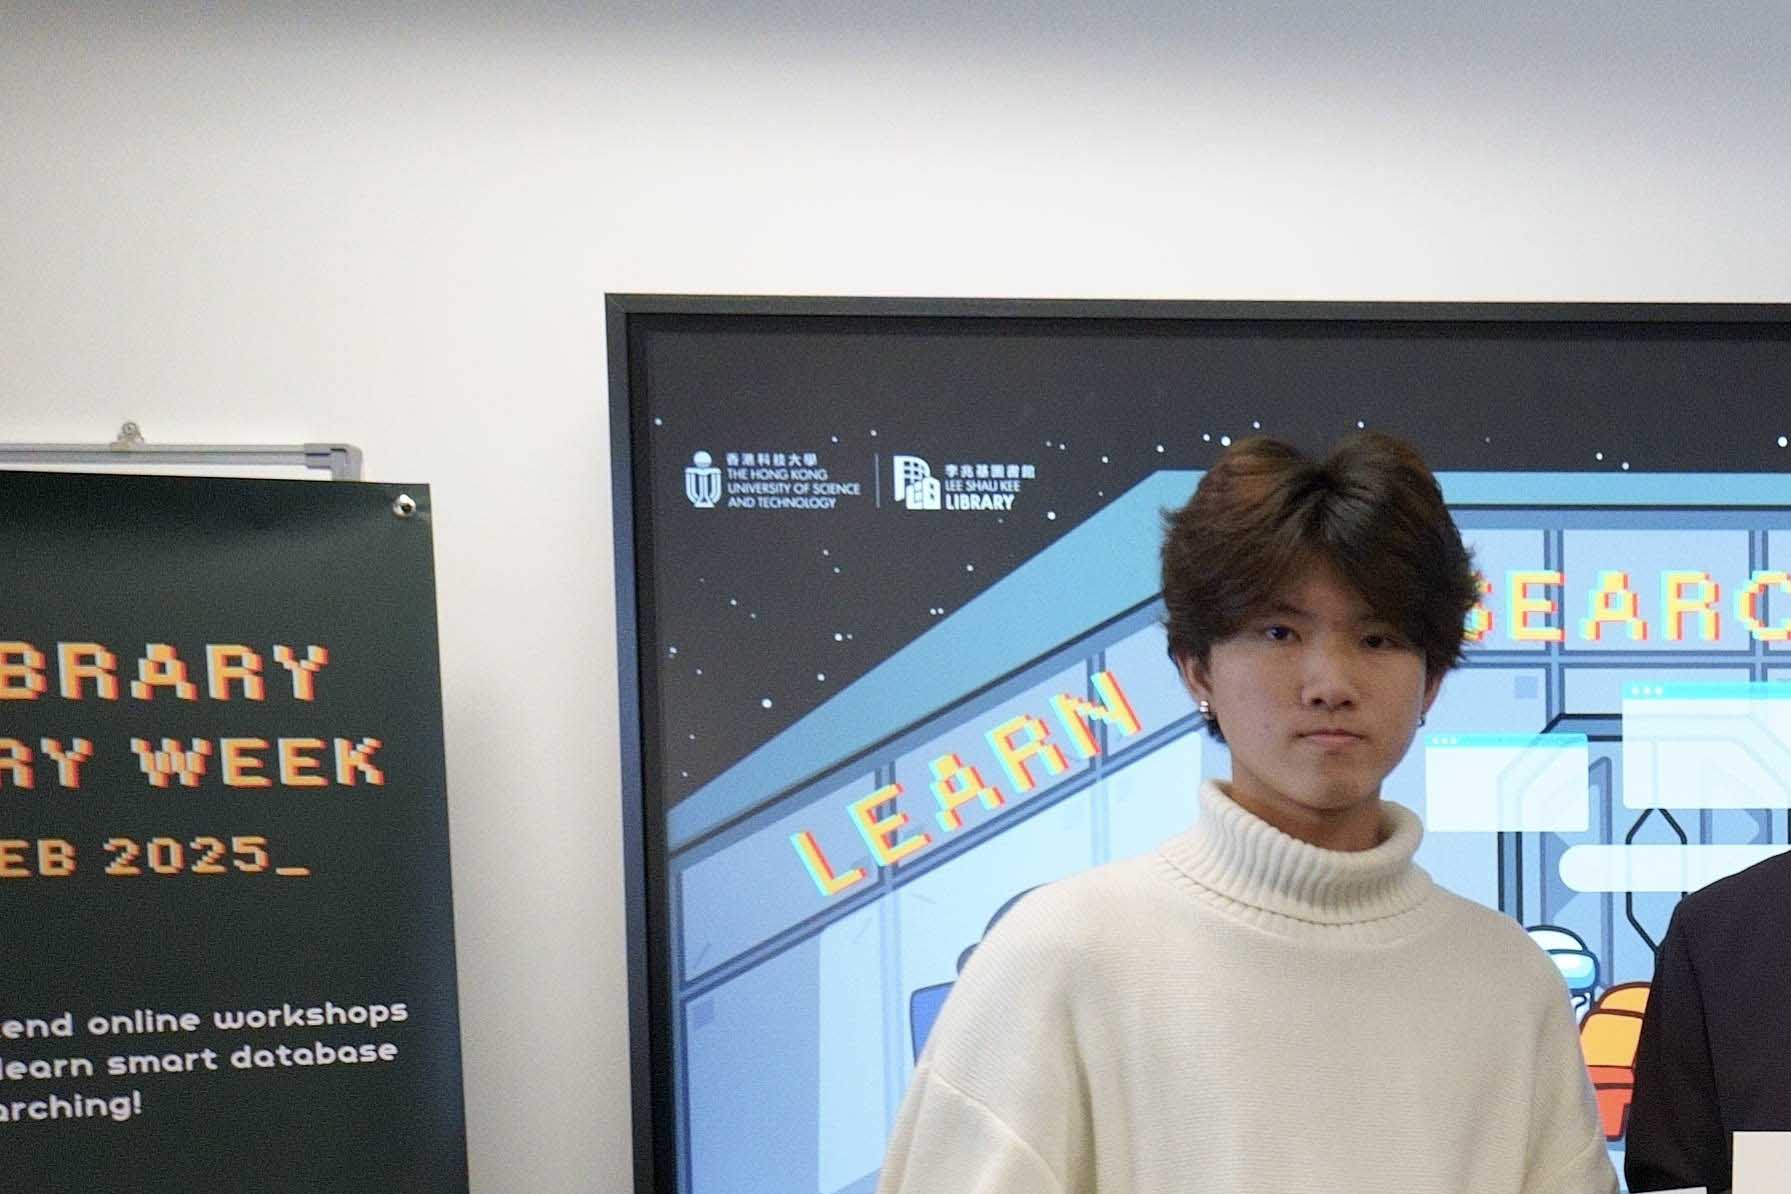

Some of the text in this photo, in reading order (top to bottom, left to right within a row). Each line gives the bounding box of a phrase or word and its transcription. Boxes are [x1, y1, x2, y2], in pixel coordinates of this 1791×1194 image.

[727, 468, 828, 480] THE HONG KONG
[728, 483, 861, 495] UNIVERSITY OF SCIENCE
[945, 480, 964, 491] LEE
[1000, 480, 1020, 491] KEE
[728, 497, 836, 509] AND TECHNOLOGY
[946, 494, 1015, 510] LIBRARY
[0, 641, 329, 701] BRARY
[131, 737, 384, 788] WEEK
[791, 671, 1142, 896] LEARN
[0, 838, 77, 877] EB
[1, 1001, 409, 1039] end online workshops
[107, 1048, 217, 1076] smart
[231, 1039, 398, 1069] database
